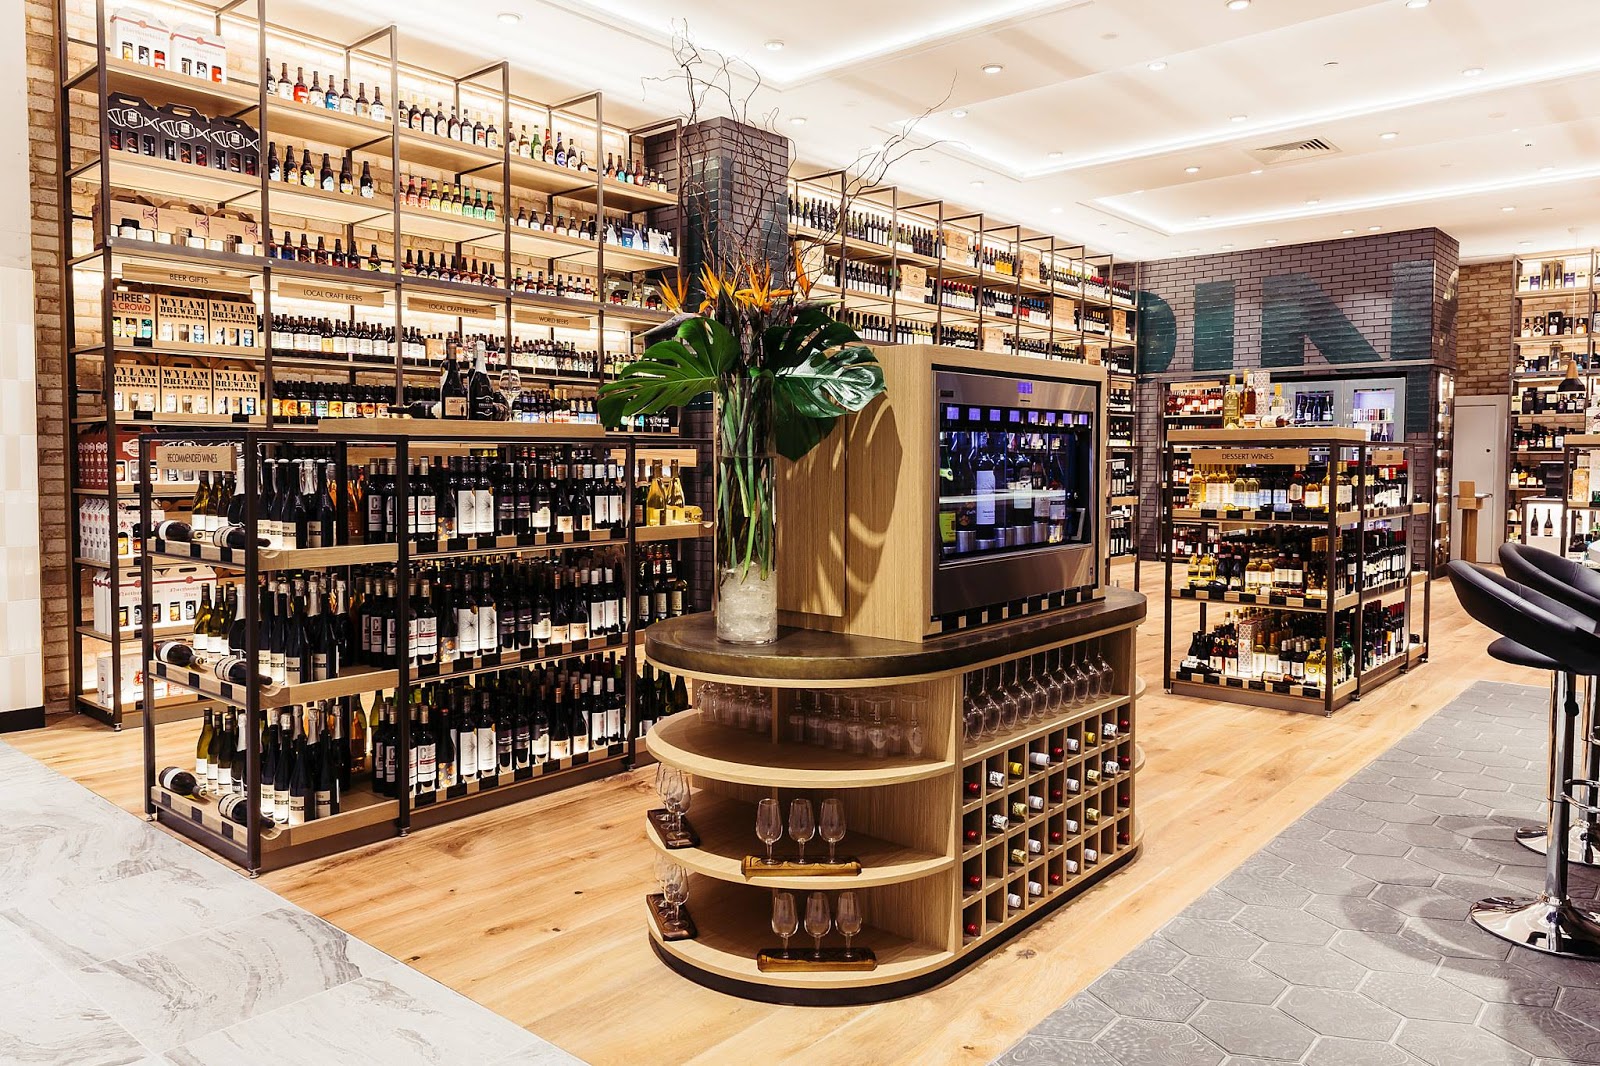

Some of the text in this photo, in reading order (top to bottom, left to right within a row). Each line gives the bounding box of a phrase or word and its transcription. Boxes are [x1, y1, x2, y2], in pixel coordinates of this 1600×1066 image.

[169, 273, 209, 284] BEER GIFTS
[112, 292, 151, 304] THREE'S
[303, 289, 363, 302] LOCAL CRAFT BEERS
[118, 302, 152, 312] CROWD
[160, 297, 205, 310] WYLAM
[212, 302, 255, 315] WYLAM
[428, 303, 478, 315] LOCAL CRAFT BEERS
[160, 306, 206, 317] BREWERY
[212, 311, 256, 321] BREWERY
[538, 315, 569, 325] WORLD BEERS
[115, 375, 158, 384] REWERY
[163, 369, 209, 380] WYLAM
[215, 372, 257, 383] WYLAM
[163, 377, 210, 387] BREWERY
[215, 380, 258, 389] BREWERY
[167, 453, 218, 464] RECOMMENDED WINES
